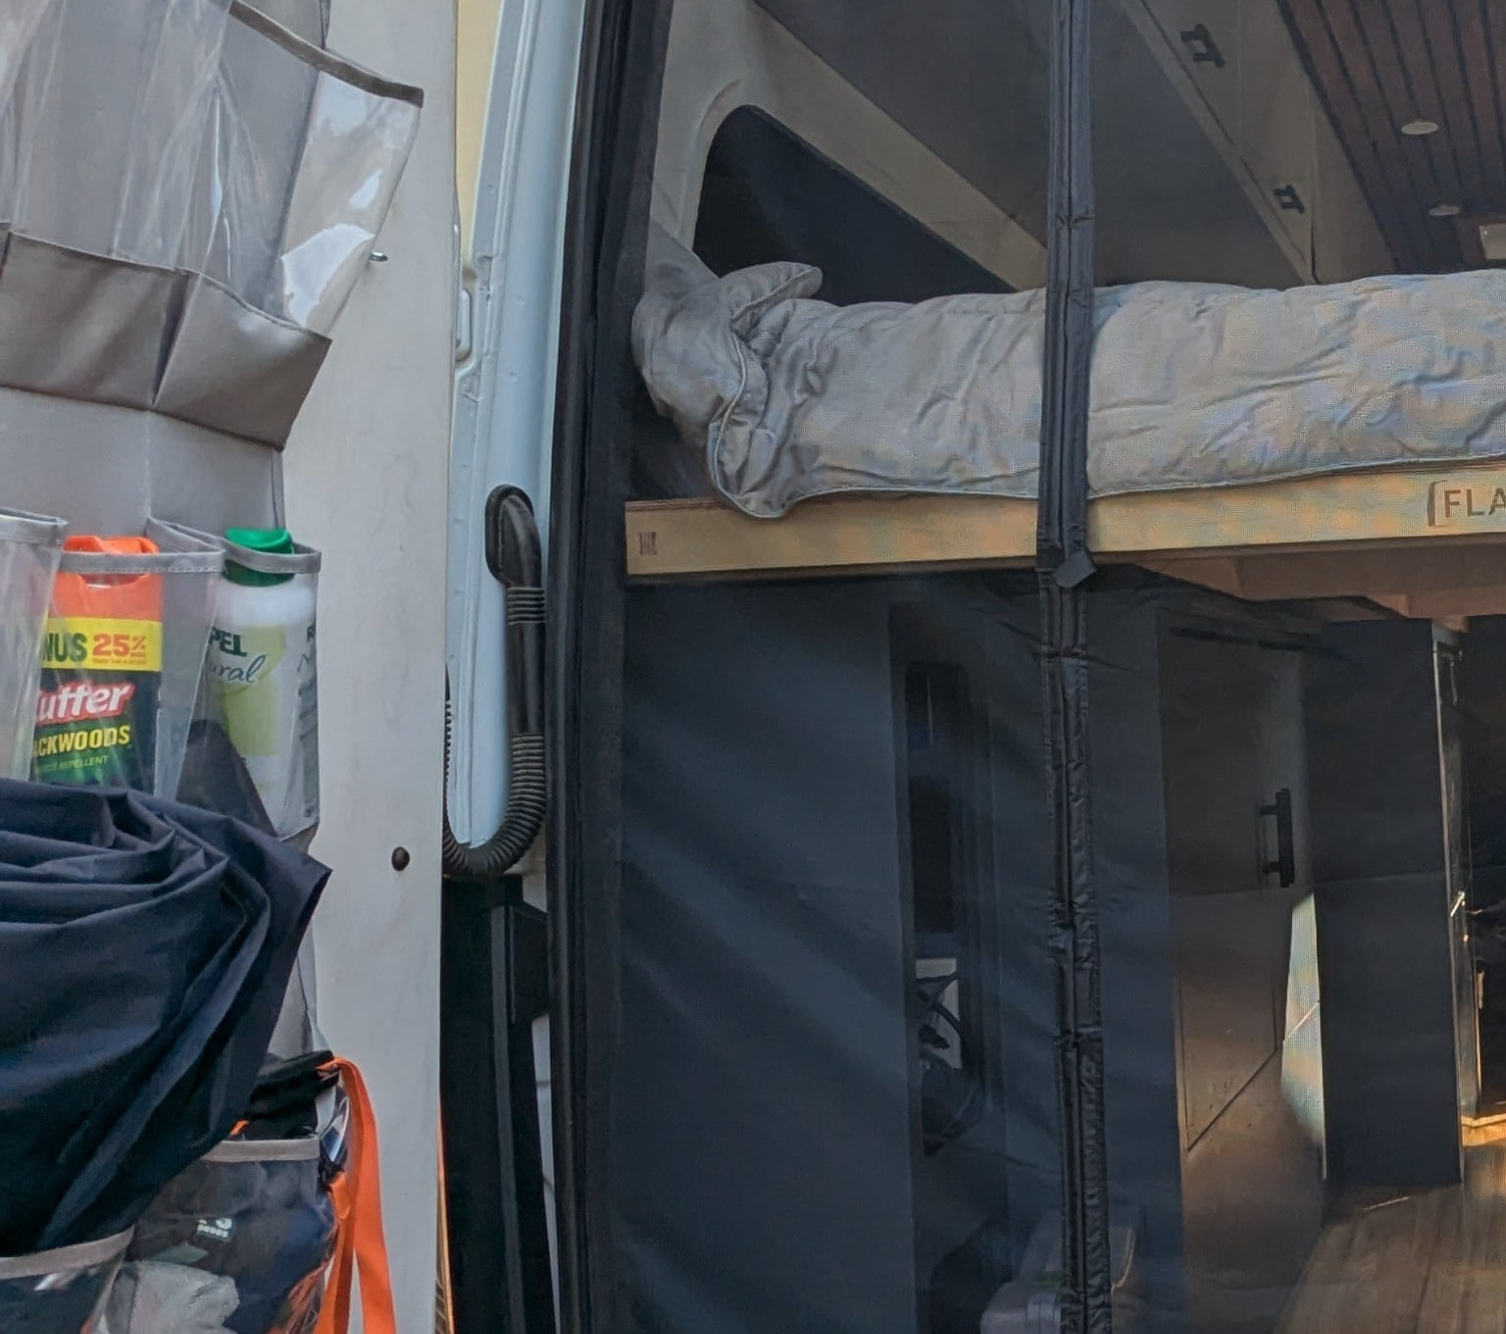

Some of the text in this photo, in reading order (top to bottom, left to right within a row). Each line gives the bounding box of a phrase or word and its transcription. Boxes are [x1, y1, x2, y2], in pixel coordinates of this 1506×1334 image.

[40, 632, 88, 663] NUS
[208, 626, 248, 657] PEL
[38, 683, 131, 721] utter
